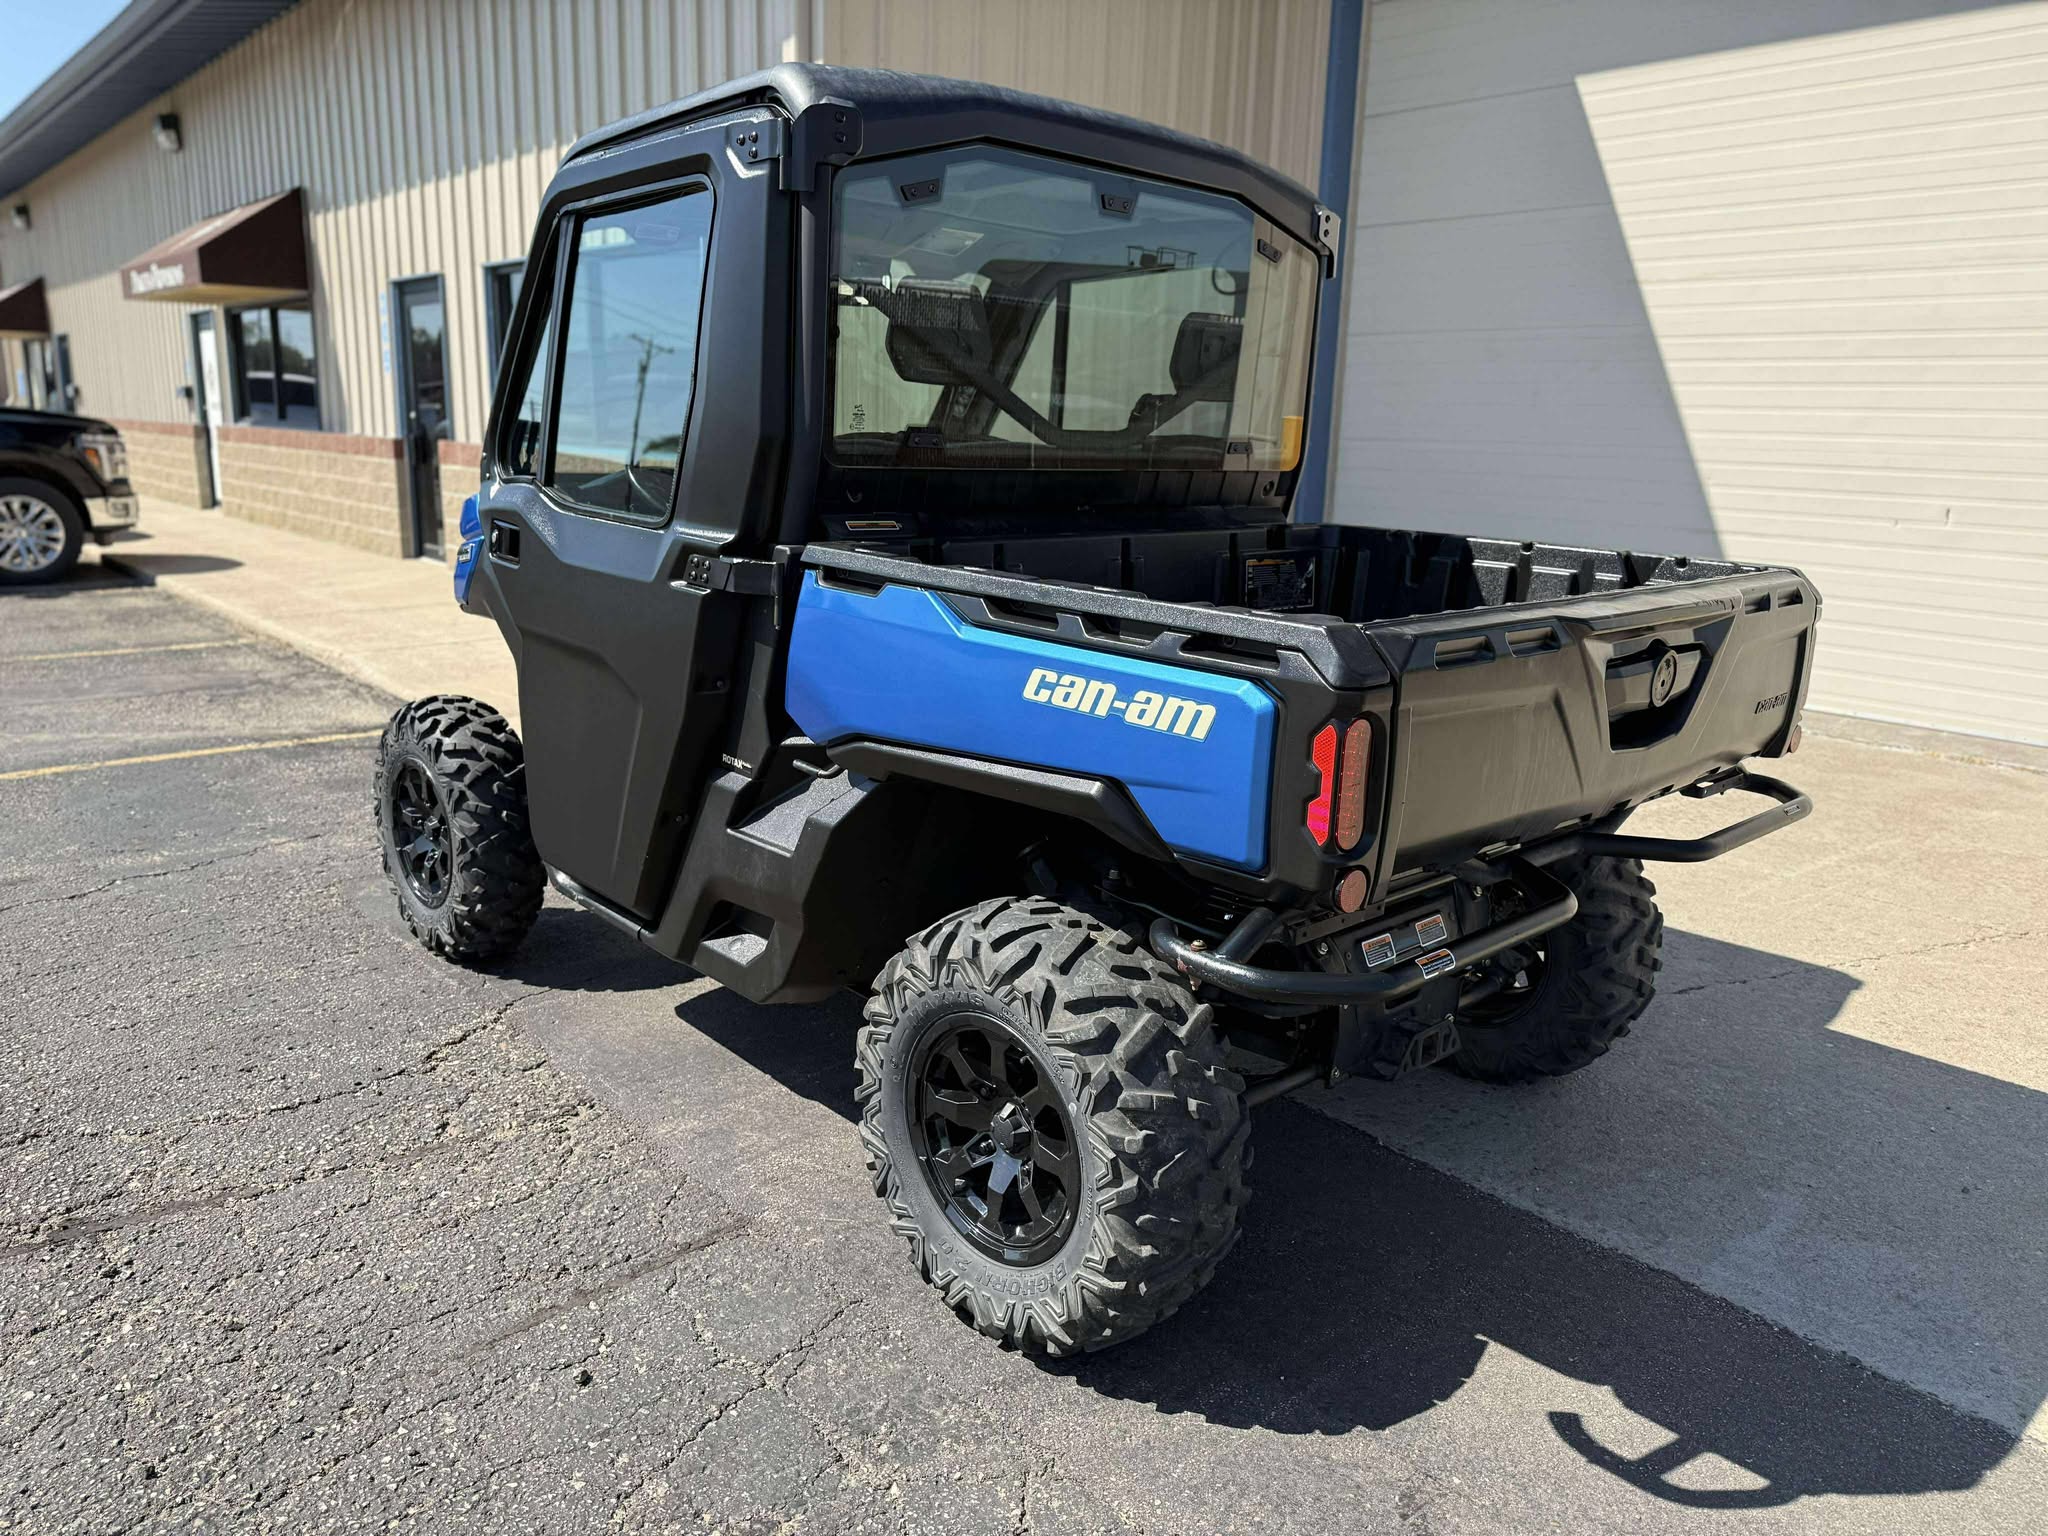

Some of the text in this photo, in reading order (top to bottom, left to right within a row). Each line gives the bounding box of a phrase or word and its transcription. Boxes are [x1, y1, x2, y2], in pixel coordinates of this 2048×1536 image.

[1023, 668, 1216, 741] can-am
[722, 753, 743, 770] ROTAX
[938, 1237, 1068, 1297] BIGHORN 2.0
